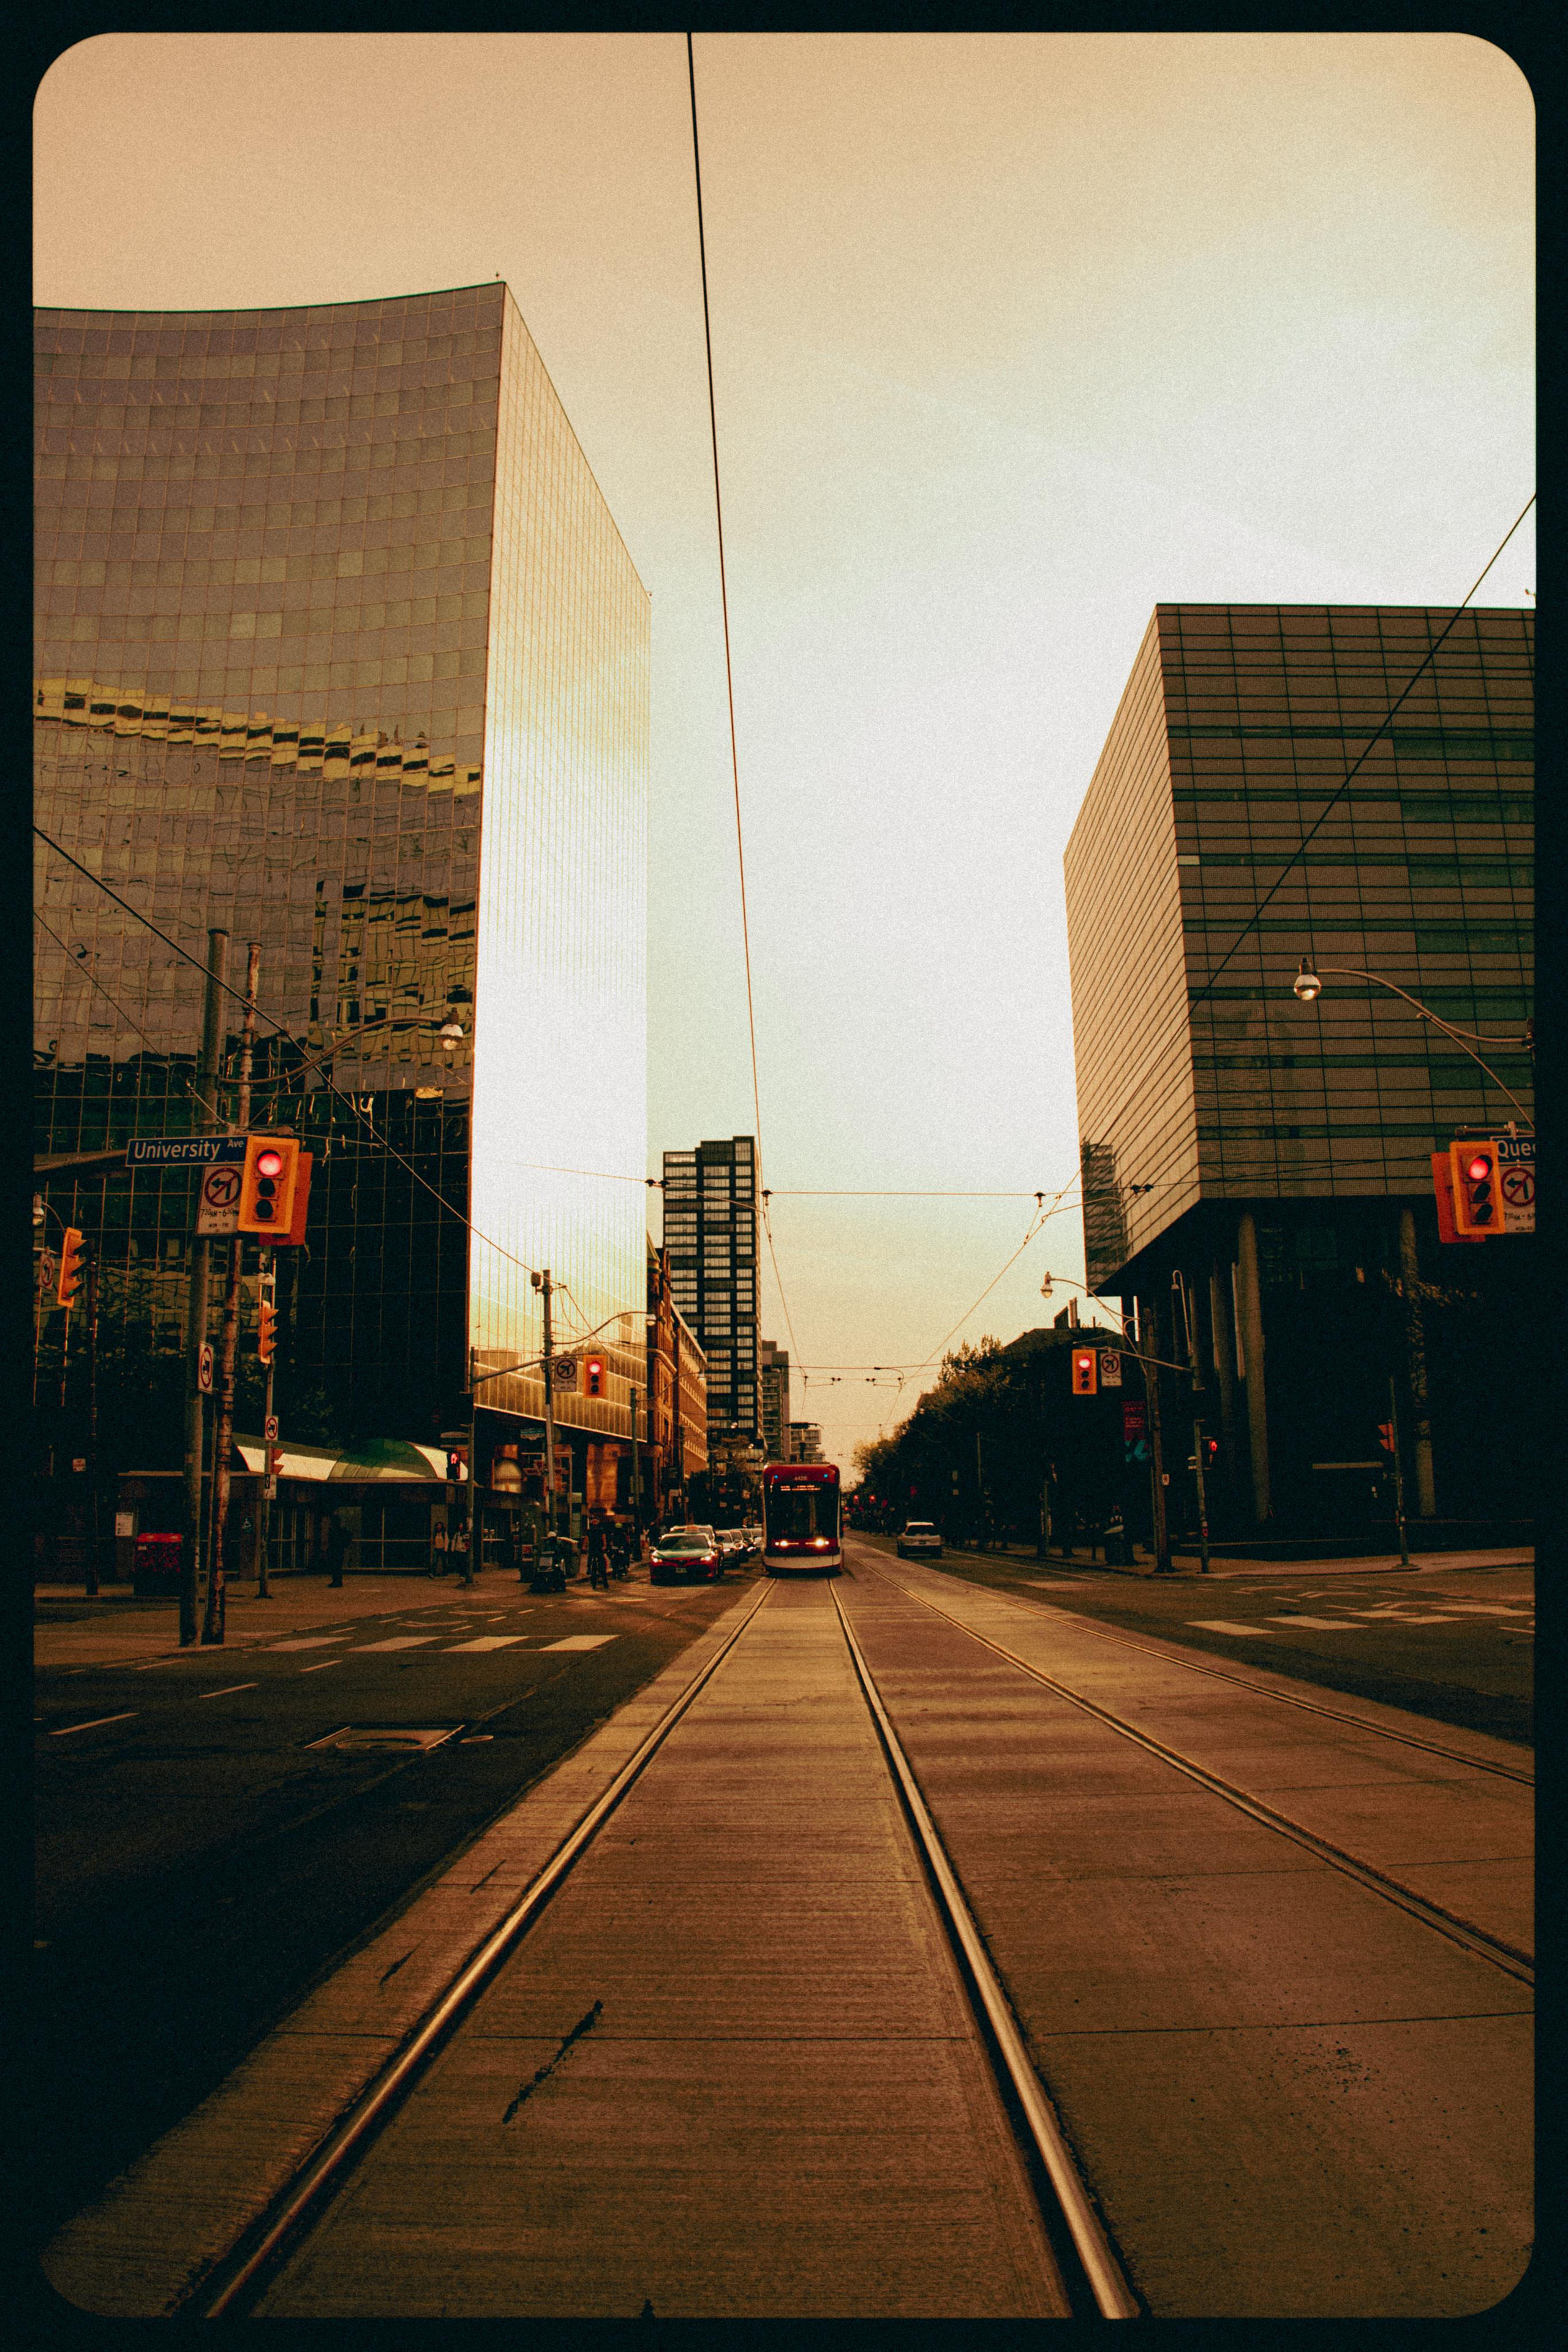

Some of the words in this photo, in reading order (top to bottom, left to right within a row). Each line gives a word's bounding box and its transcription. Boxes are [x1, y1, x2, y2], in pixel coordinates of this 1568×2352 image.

[135, 1140, 221, 1161] University
[227, 1139, 244, 1148] Ave
[1498, 1140, 1536, 1158] Que
